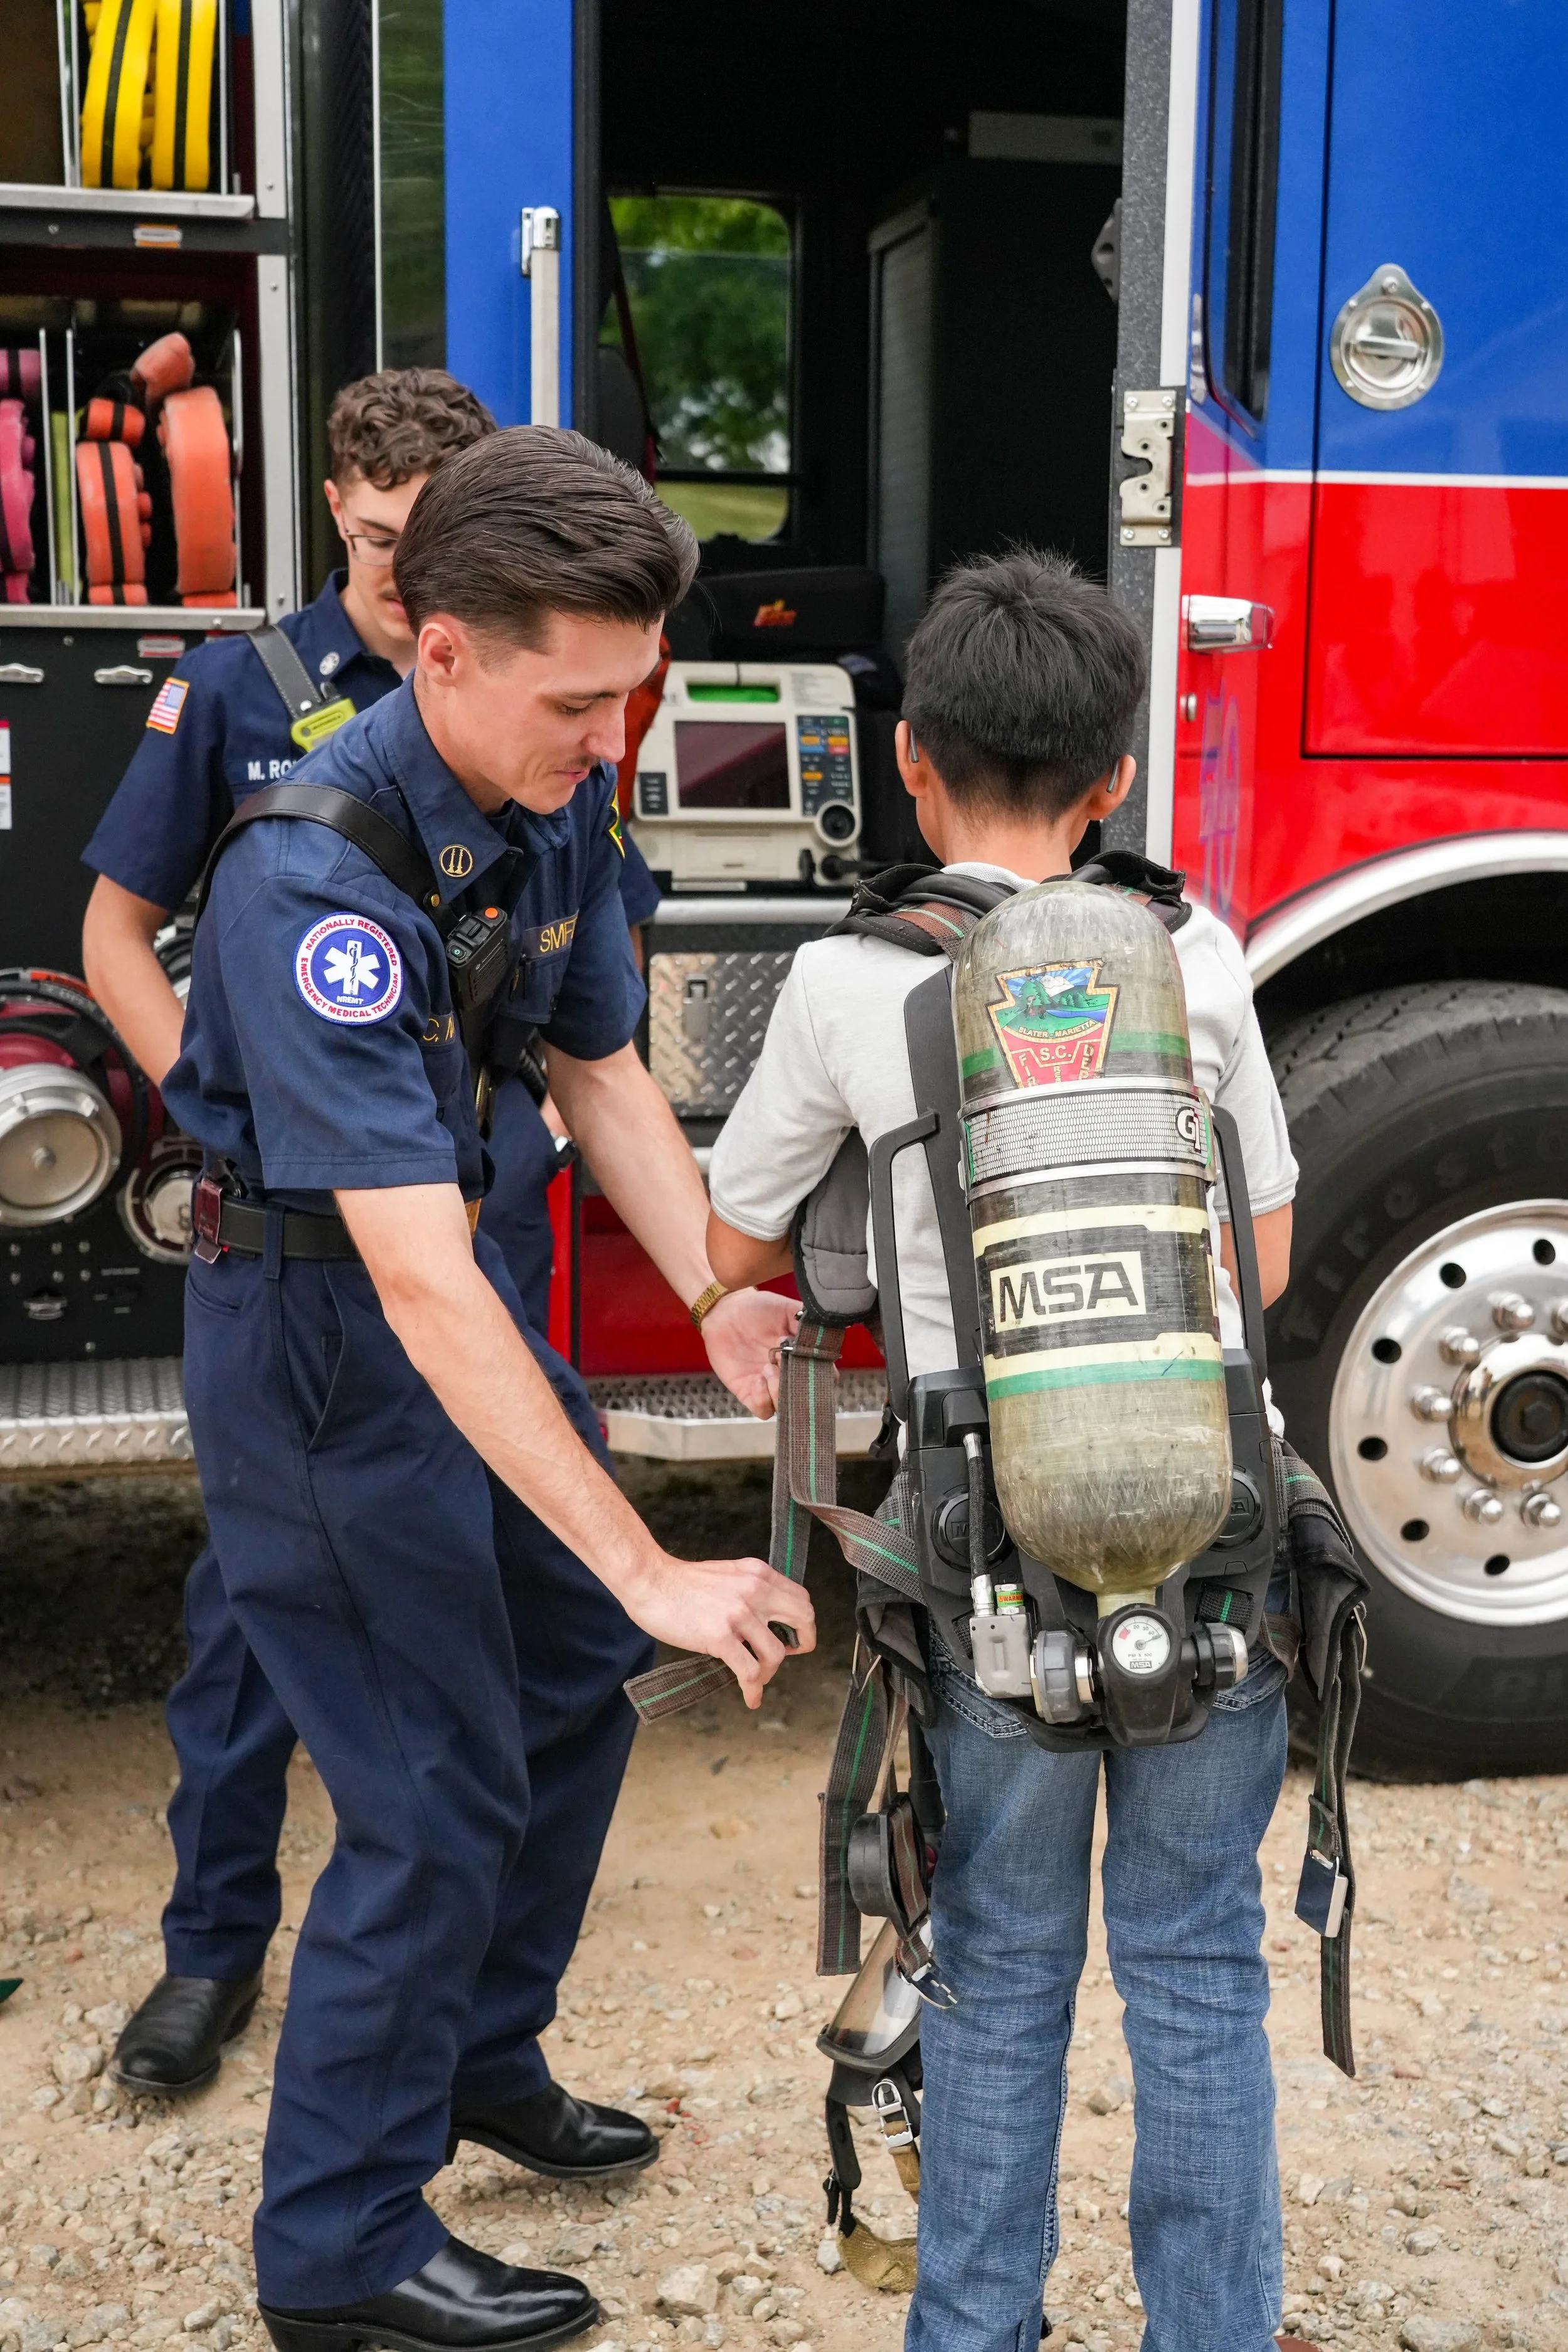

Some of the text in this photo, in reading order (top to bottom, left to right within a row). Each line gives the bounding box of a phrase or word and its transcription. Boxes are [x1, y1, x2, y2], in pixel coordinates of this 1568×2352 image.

[248, 759, 297, 780] M. RO
[305, 919, 397, 966] NATIONALLY REGISTERED
[300, 957, 398, 1017] EMERGENCY MEDICAL TECHNICIAN
[336, 995, 364, 1005] NREMT
[1018, 1026, 1049, 1038] SLATER
[1054, 1019, 1098, 1038] MARIETTA
[1039, 1045, 1072, 1061] S.C.
[999, 1261, 1138, 1322] MSA
